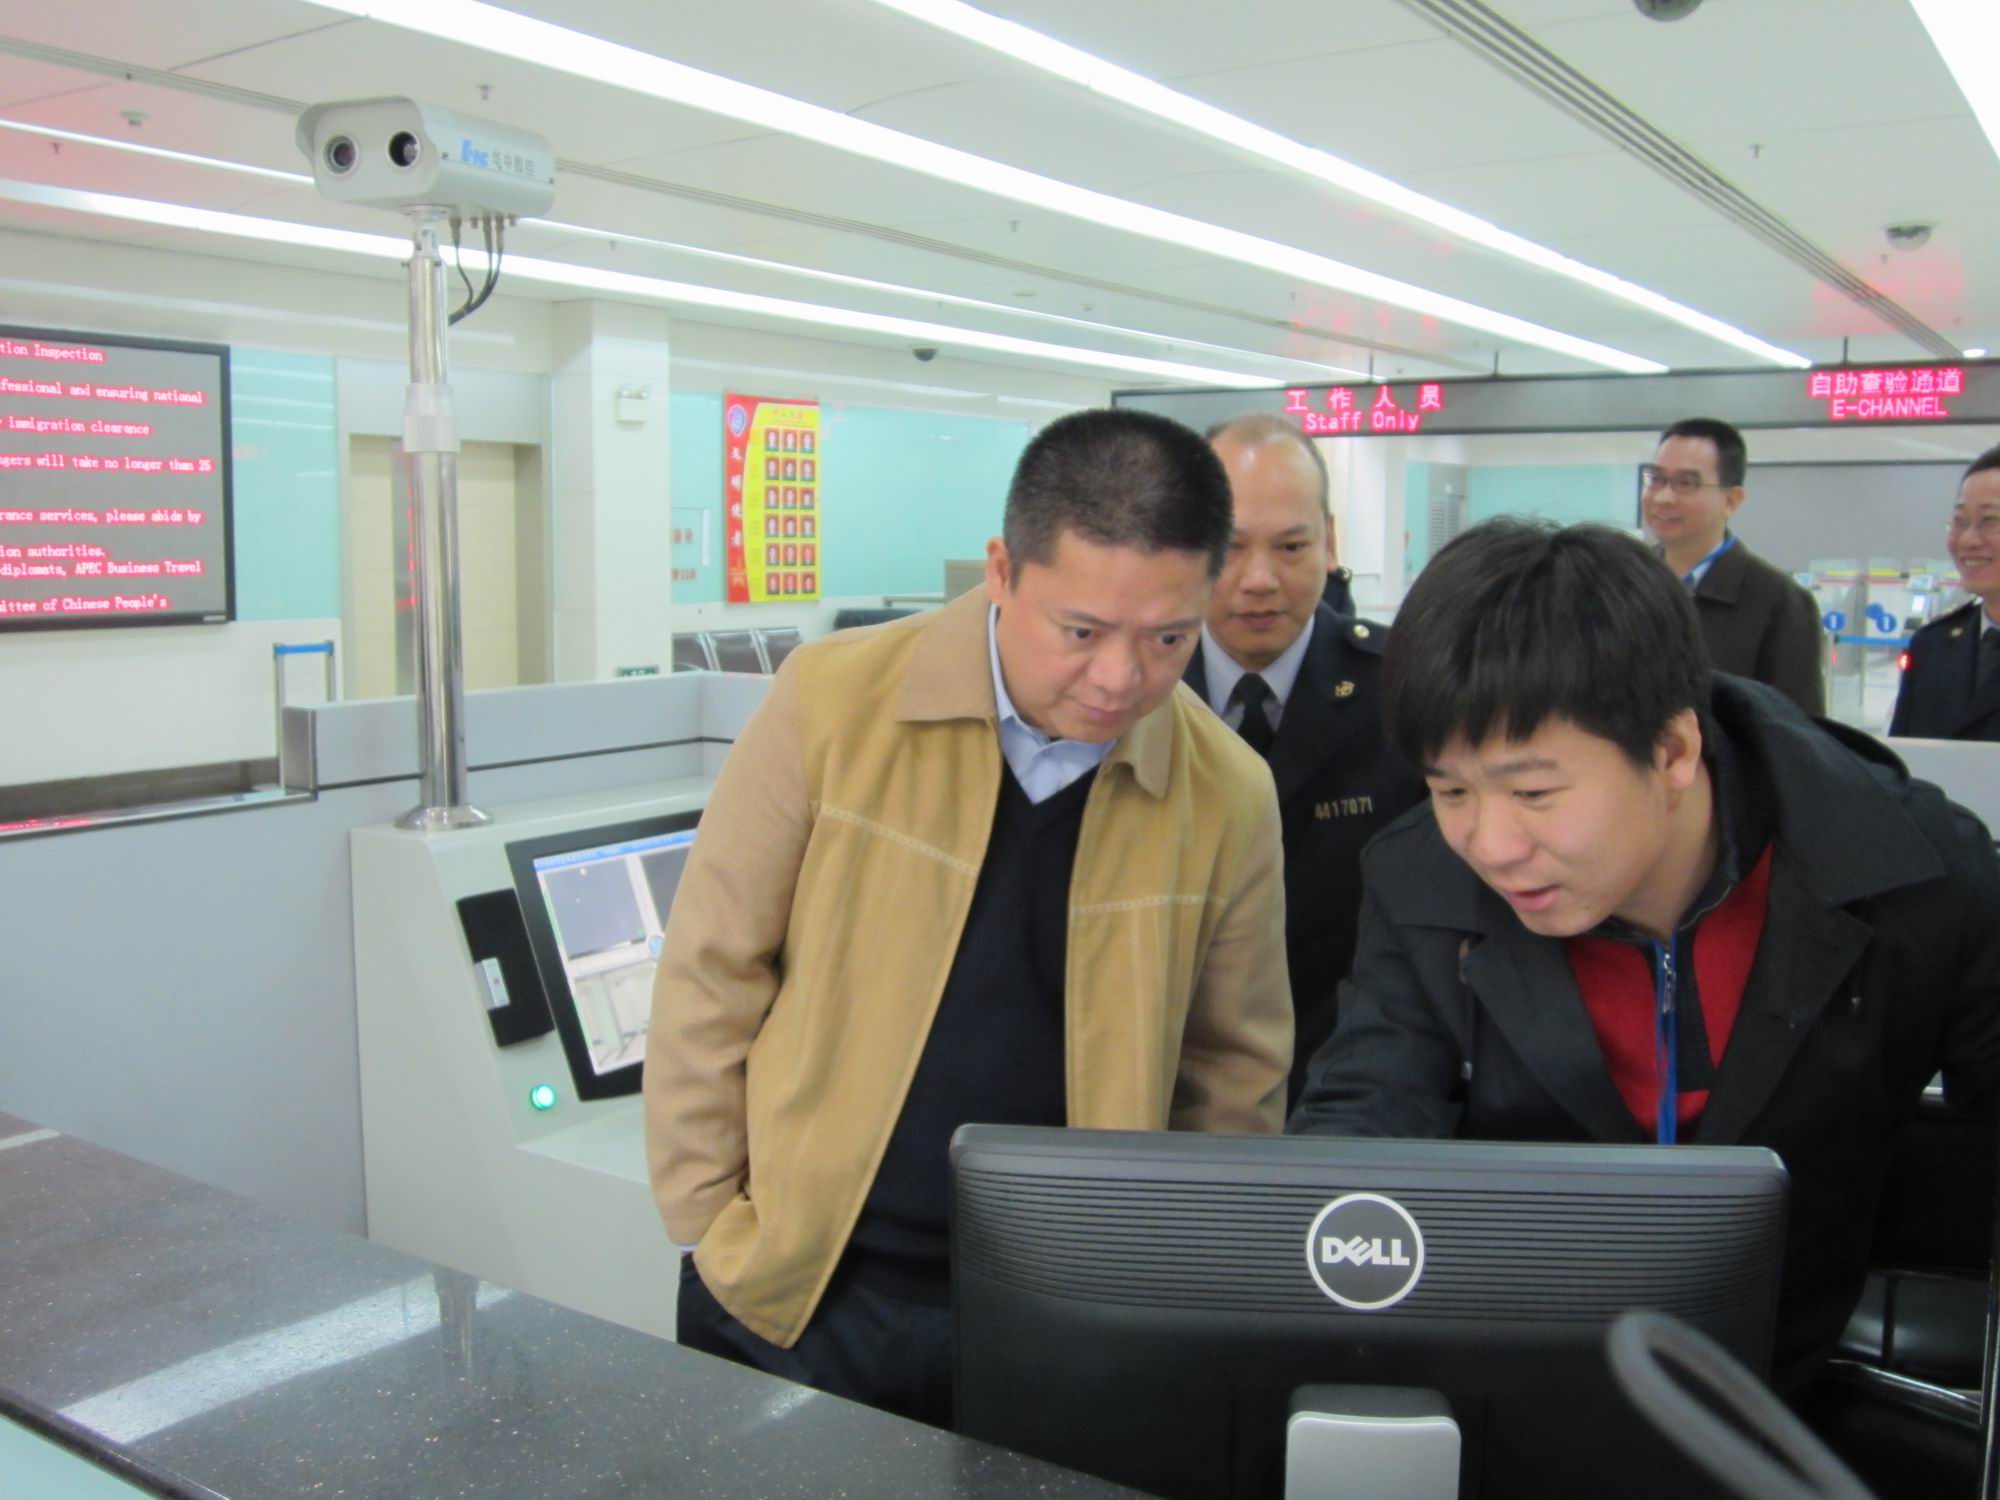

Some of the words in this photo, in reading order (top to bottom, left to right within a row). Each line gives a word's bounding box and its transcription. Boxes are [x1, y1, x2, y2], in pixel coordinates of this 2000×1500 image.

[34, 343, 104, 362] Inspection
[1811, 368, 1962, 396] 自助查验通道
[69, 383, 91, 397] and
[96, 386, 149, 403] ensuring
[153, 389, 203, 404] national
[1832, 396, 1948, 419] E-CHANNEL
[8, 415, 86, 432] immigration
[90, 420, 150, 436] clearance
[1305, 411, 1362, 432] Staff
[1372, 409, 1420, 433] Only
[36, 453, 65, 468] will
[72, 455, 99, 469] take
[104, 458, 119, 470] no
[125, 456, 163, 473] longer
[169, 457, 194, 471] than
[40, 508, 98, 523] services,
[105, 508, 145, 523] please
[151, 509, 183, 522] abide
[187, 509, 202, 524] by
[27, 544, 105, 557] authorities.
[0, 562, 67, 578] diplomats,
[75, 560, 102, 575] APEC
[107, 560, 160, 574] Business
[164, 559, 203, 574] Travel
[42, 598, 58, 611] of
[62, 596, 110, 611] Chinese
[114, 593, 167, 610] People's
[1321, 1235, 1410, 1267] DELL
